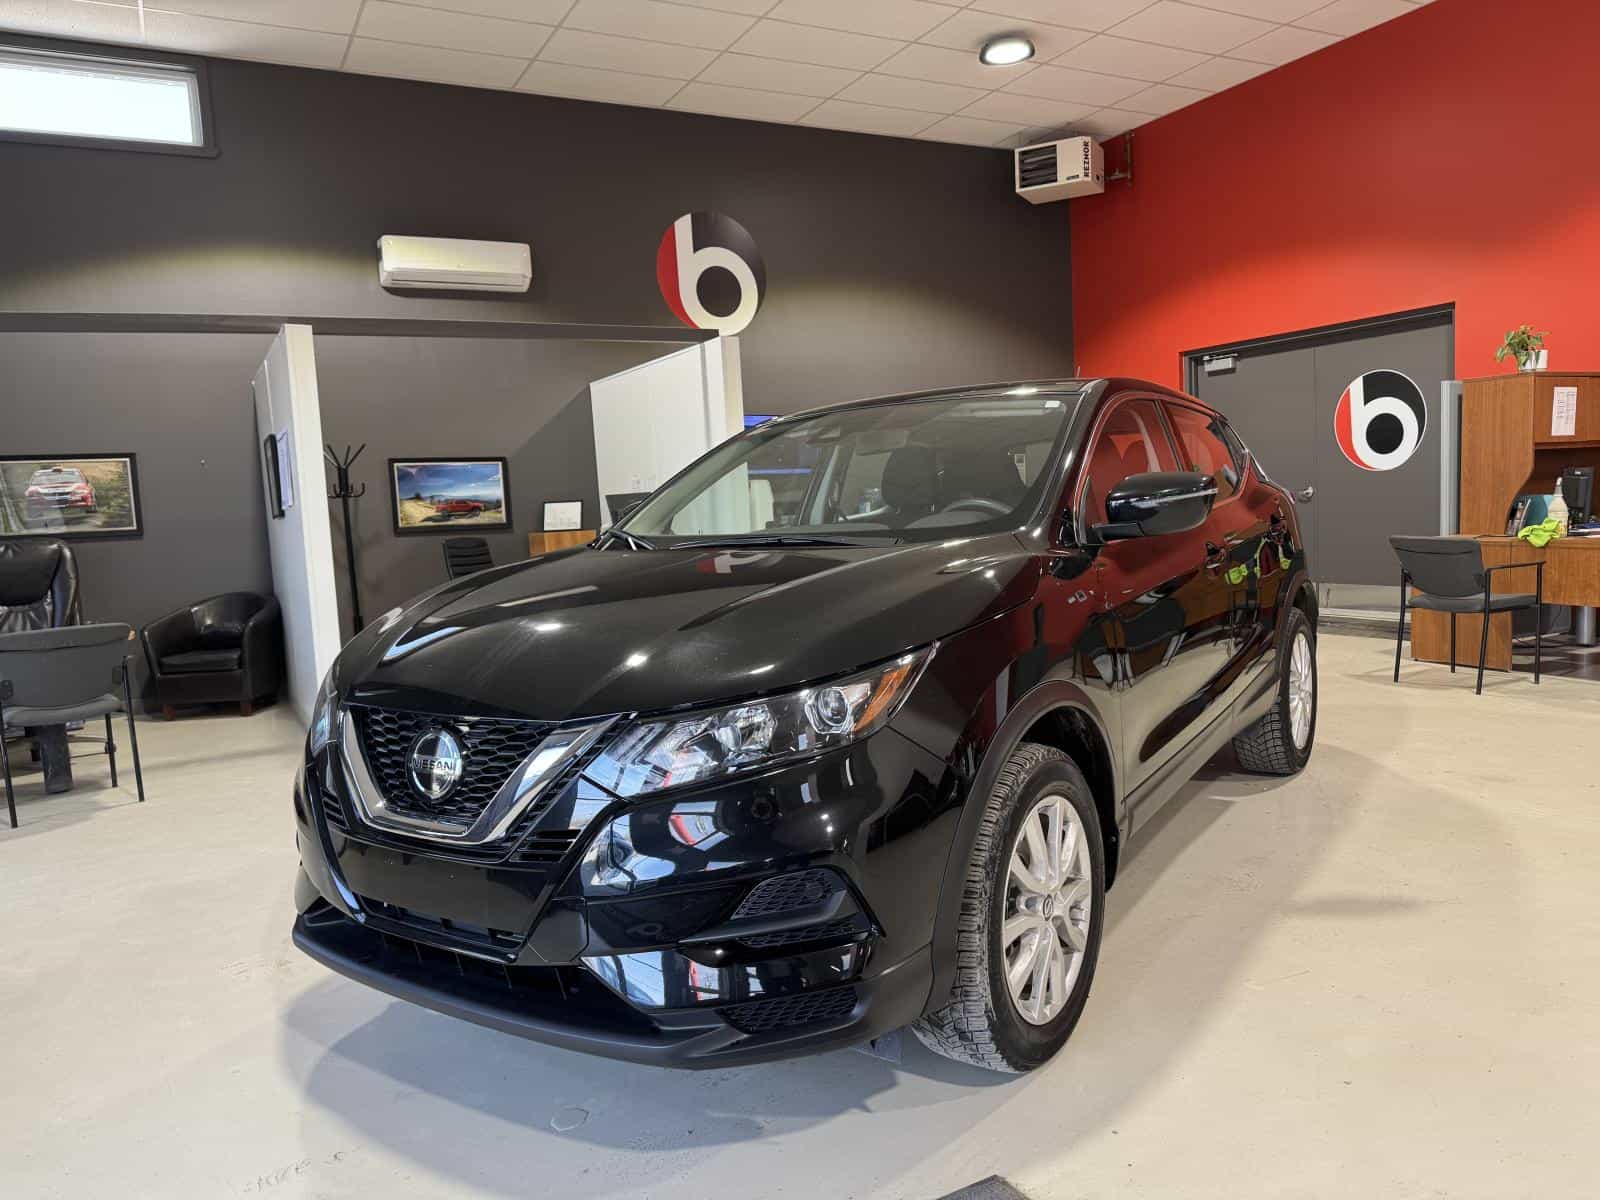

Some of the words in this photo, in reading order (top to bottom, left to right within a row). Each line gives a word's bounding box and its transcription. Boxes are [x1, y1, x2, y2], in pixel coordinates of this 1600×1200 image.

[1082, 140, 1091, 178] REZNOR
[1349, 375, 1419, 471] b
[412, 757, 453, 770] NISSAN
